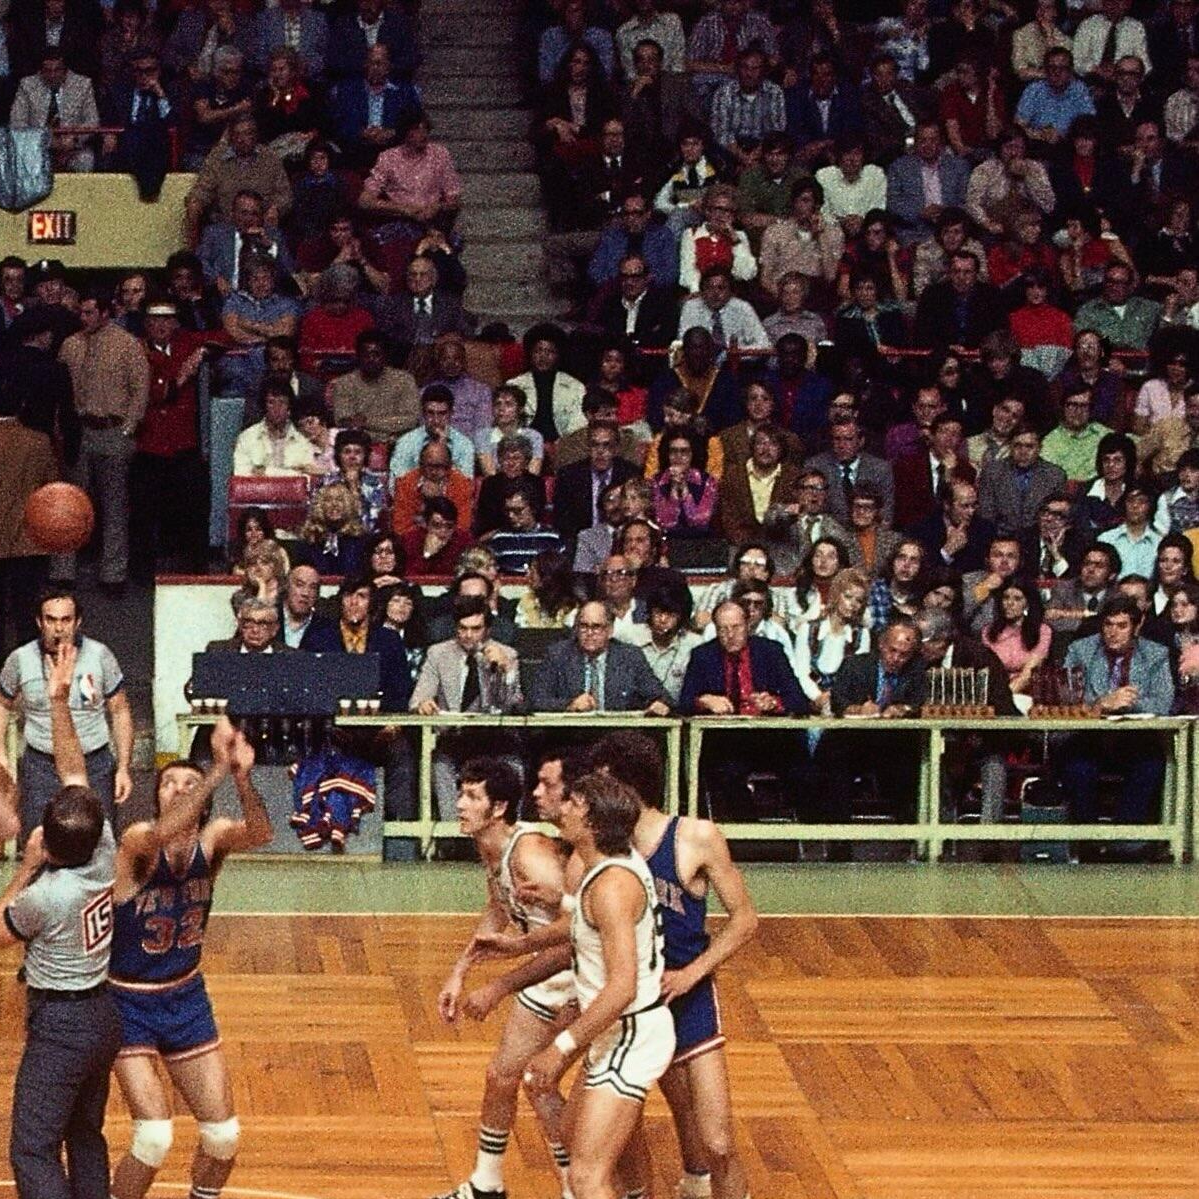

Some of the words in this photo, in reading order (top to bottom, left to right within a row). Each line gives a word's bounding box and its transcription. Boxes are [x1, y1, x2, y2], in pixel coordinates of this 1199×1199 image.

[32, 212, 71, 239] EXIT
[90, 900, 113, 939] 15
[142, 906, 203, 954] 32
